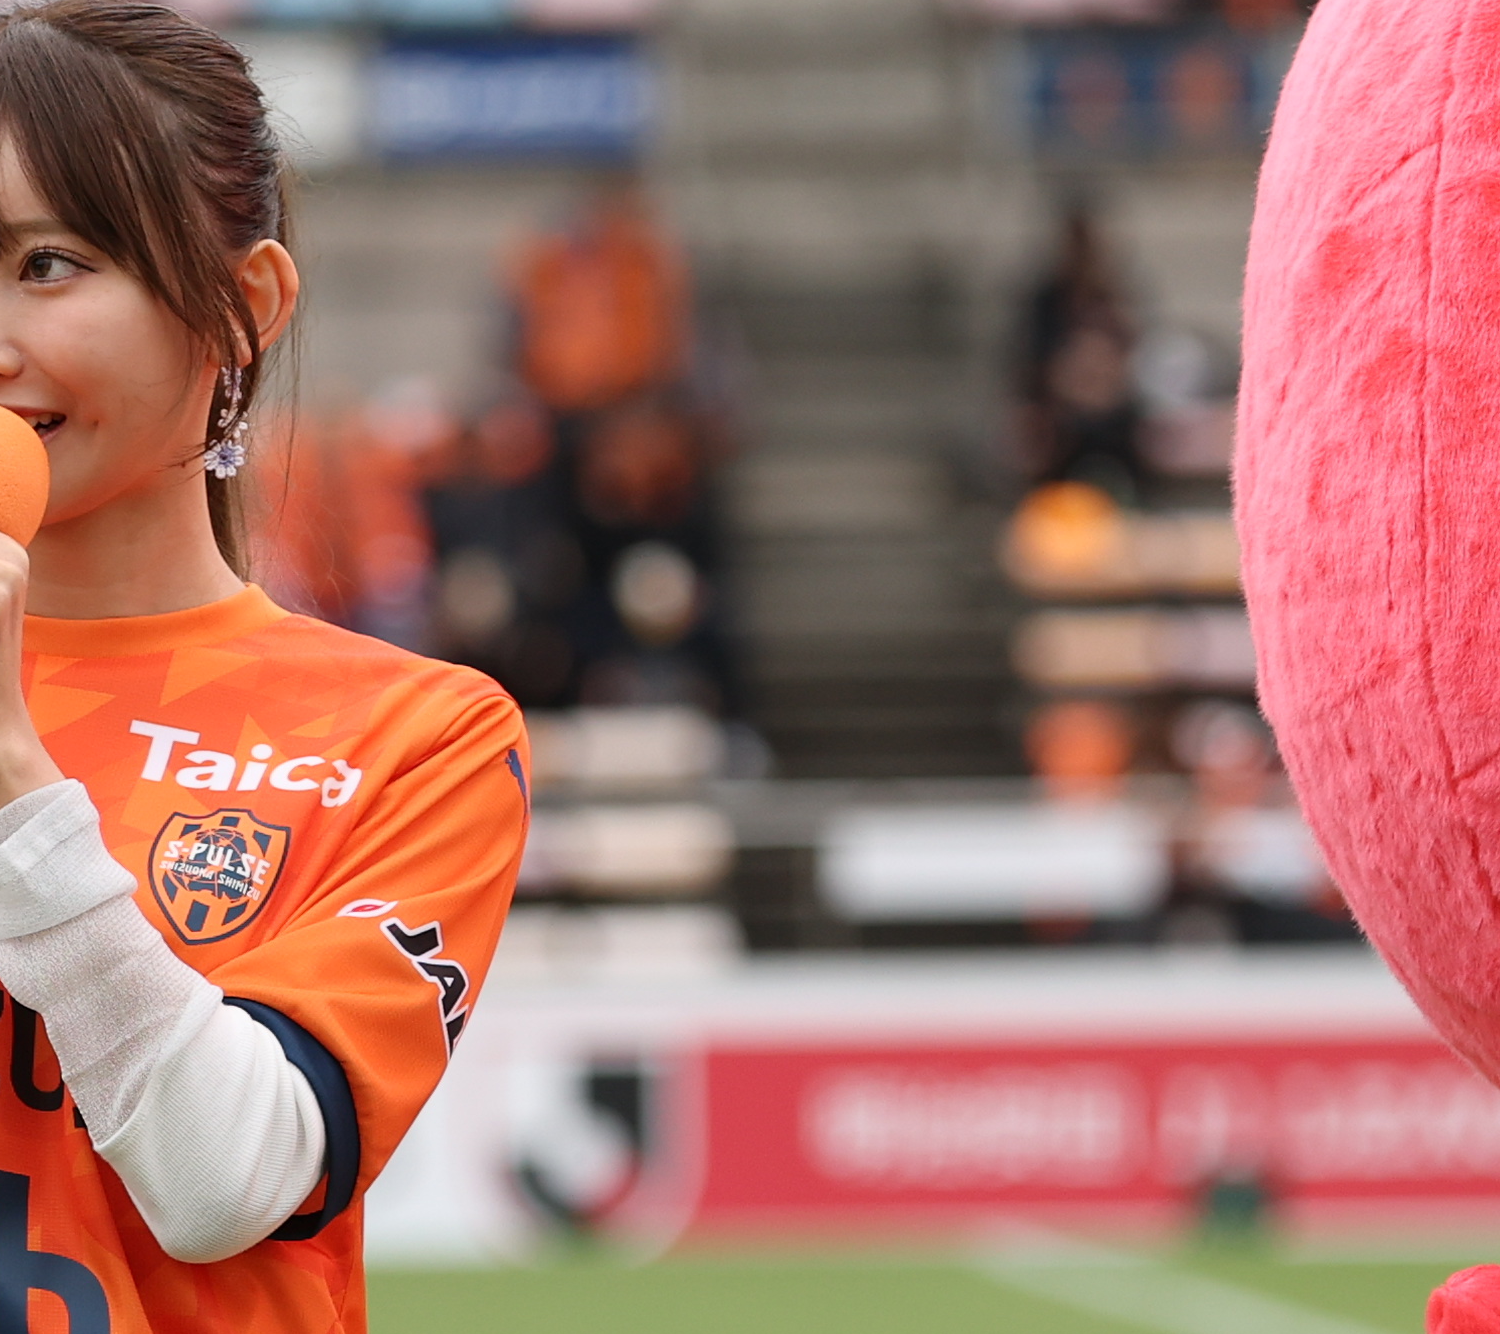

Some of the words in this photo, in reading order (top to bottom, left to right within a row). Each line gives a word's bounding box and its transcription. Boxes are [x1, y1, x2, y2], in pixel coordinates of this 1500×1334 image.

[129, 719, 363, 808] Taica
[163, 840, 271, 885] S-PULSE
[217, 874, 261, 901] SHIMIZU
